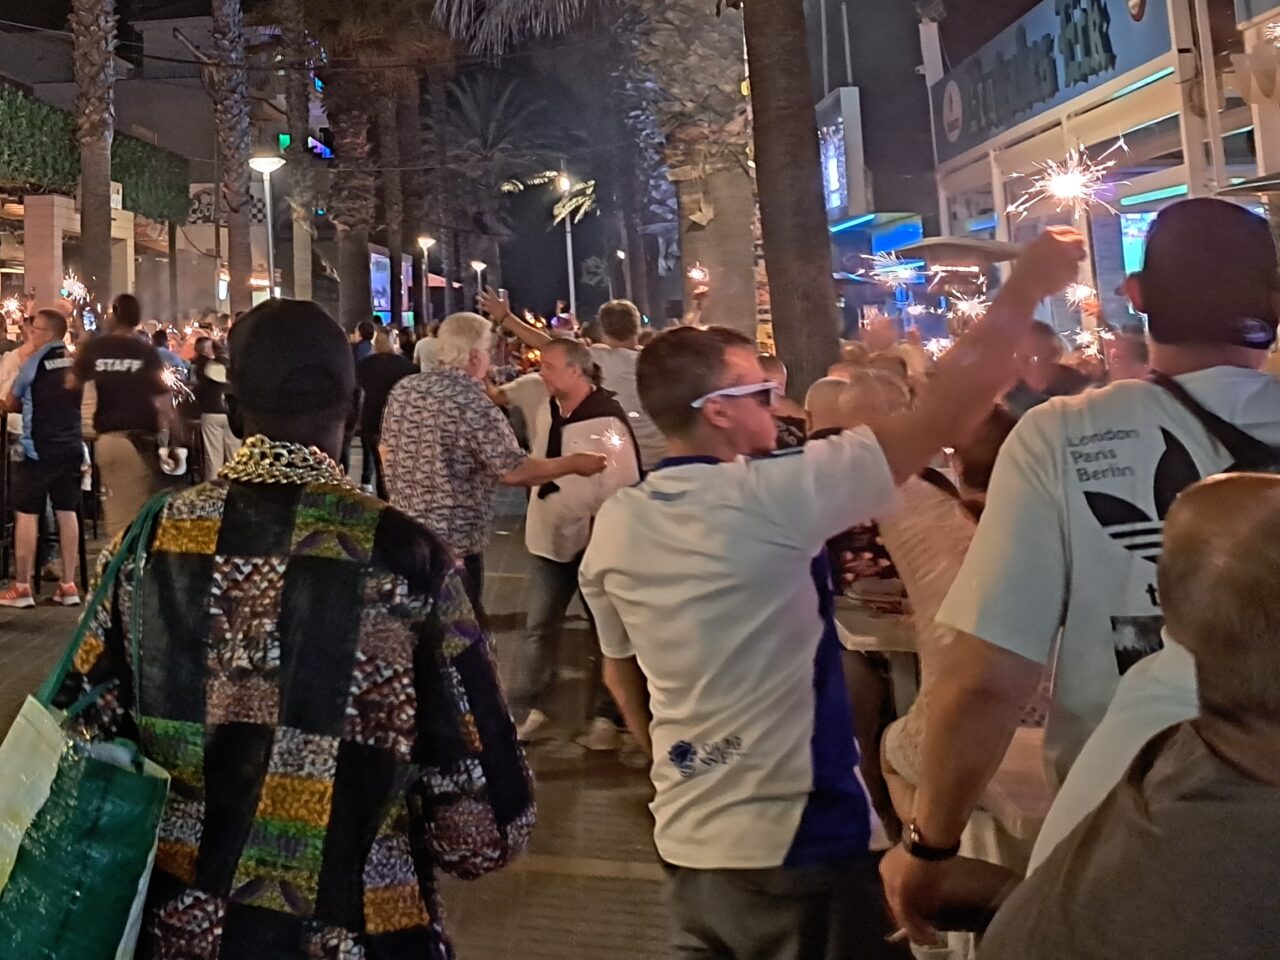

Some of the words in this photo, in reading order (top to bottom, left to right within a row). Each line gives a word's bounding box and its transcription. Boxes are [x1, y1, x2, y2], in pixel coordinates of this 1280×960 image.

[95, 358, 142, 372] STAFF
[1066, 429, 1140, 447] London
[1071, 449, 1117, 465] Paris
[1076, 465, 1135, 483] Berlin
